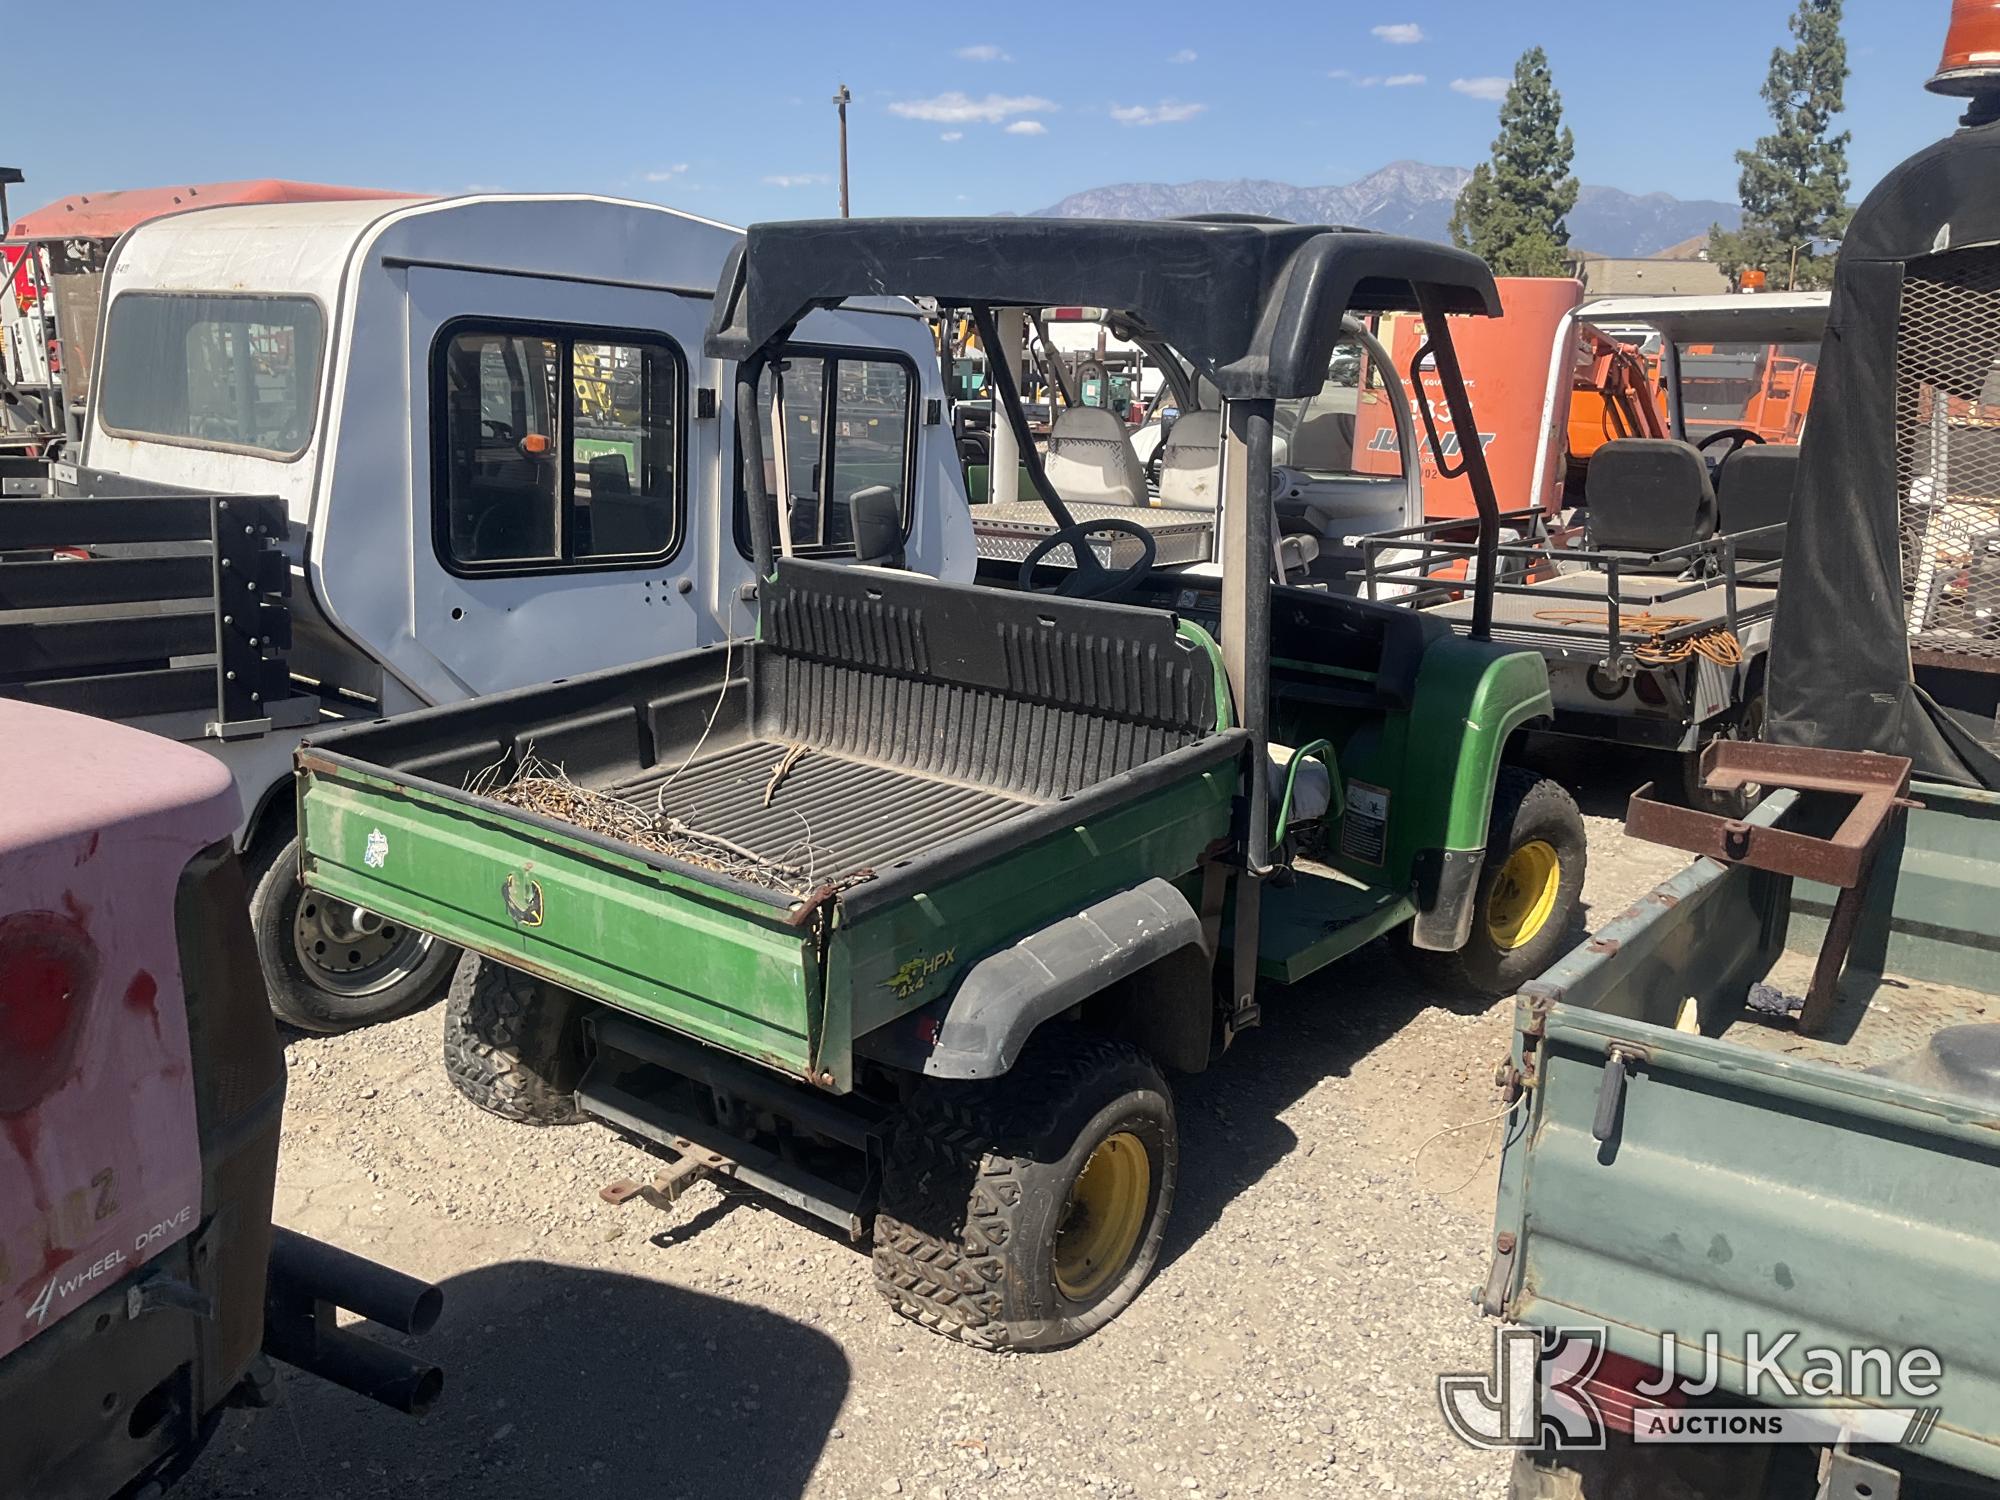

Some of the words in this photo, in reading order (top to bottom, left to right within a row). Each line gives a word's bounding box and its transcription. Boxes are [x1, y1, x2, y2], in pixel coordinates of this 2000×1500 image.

[922, 945, 957, 976] HPX
[898, 976, 925, 999] 4x4
[25, 1276, 57, 1326] 4
[58, 1249, 127, 1298] WHEEL
[134, 1205, 192, 1251] DRIVE
